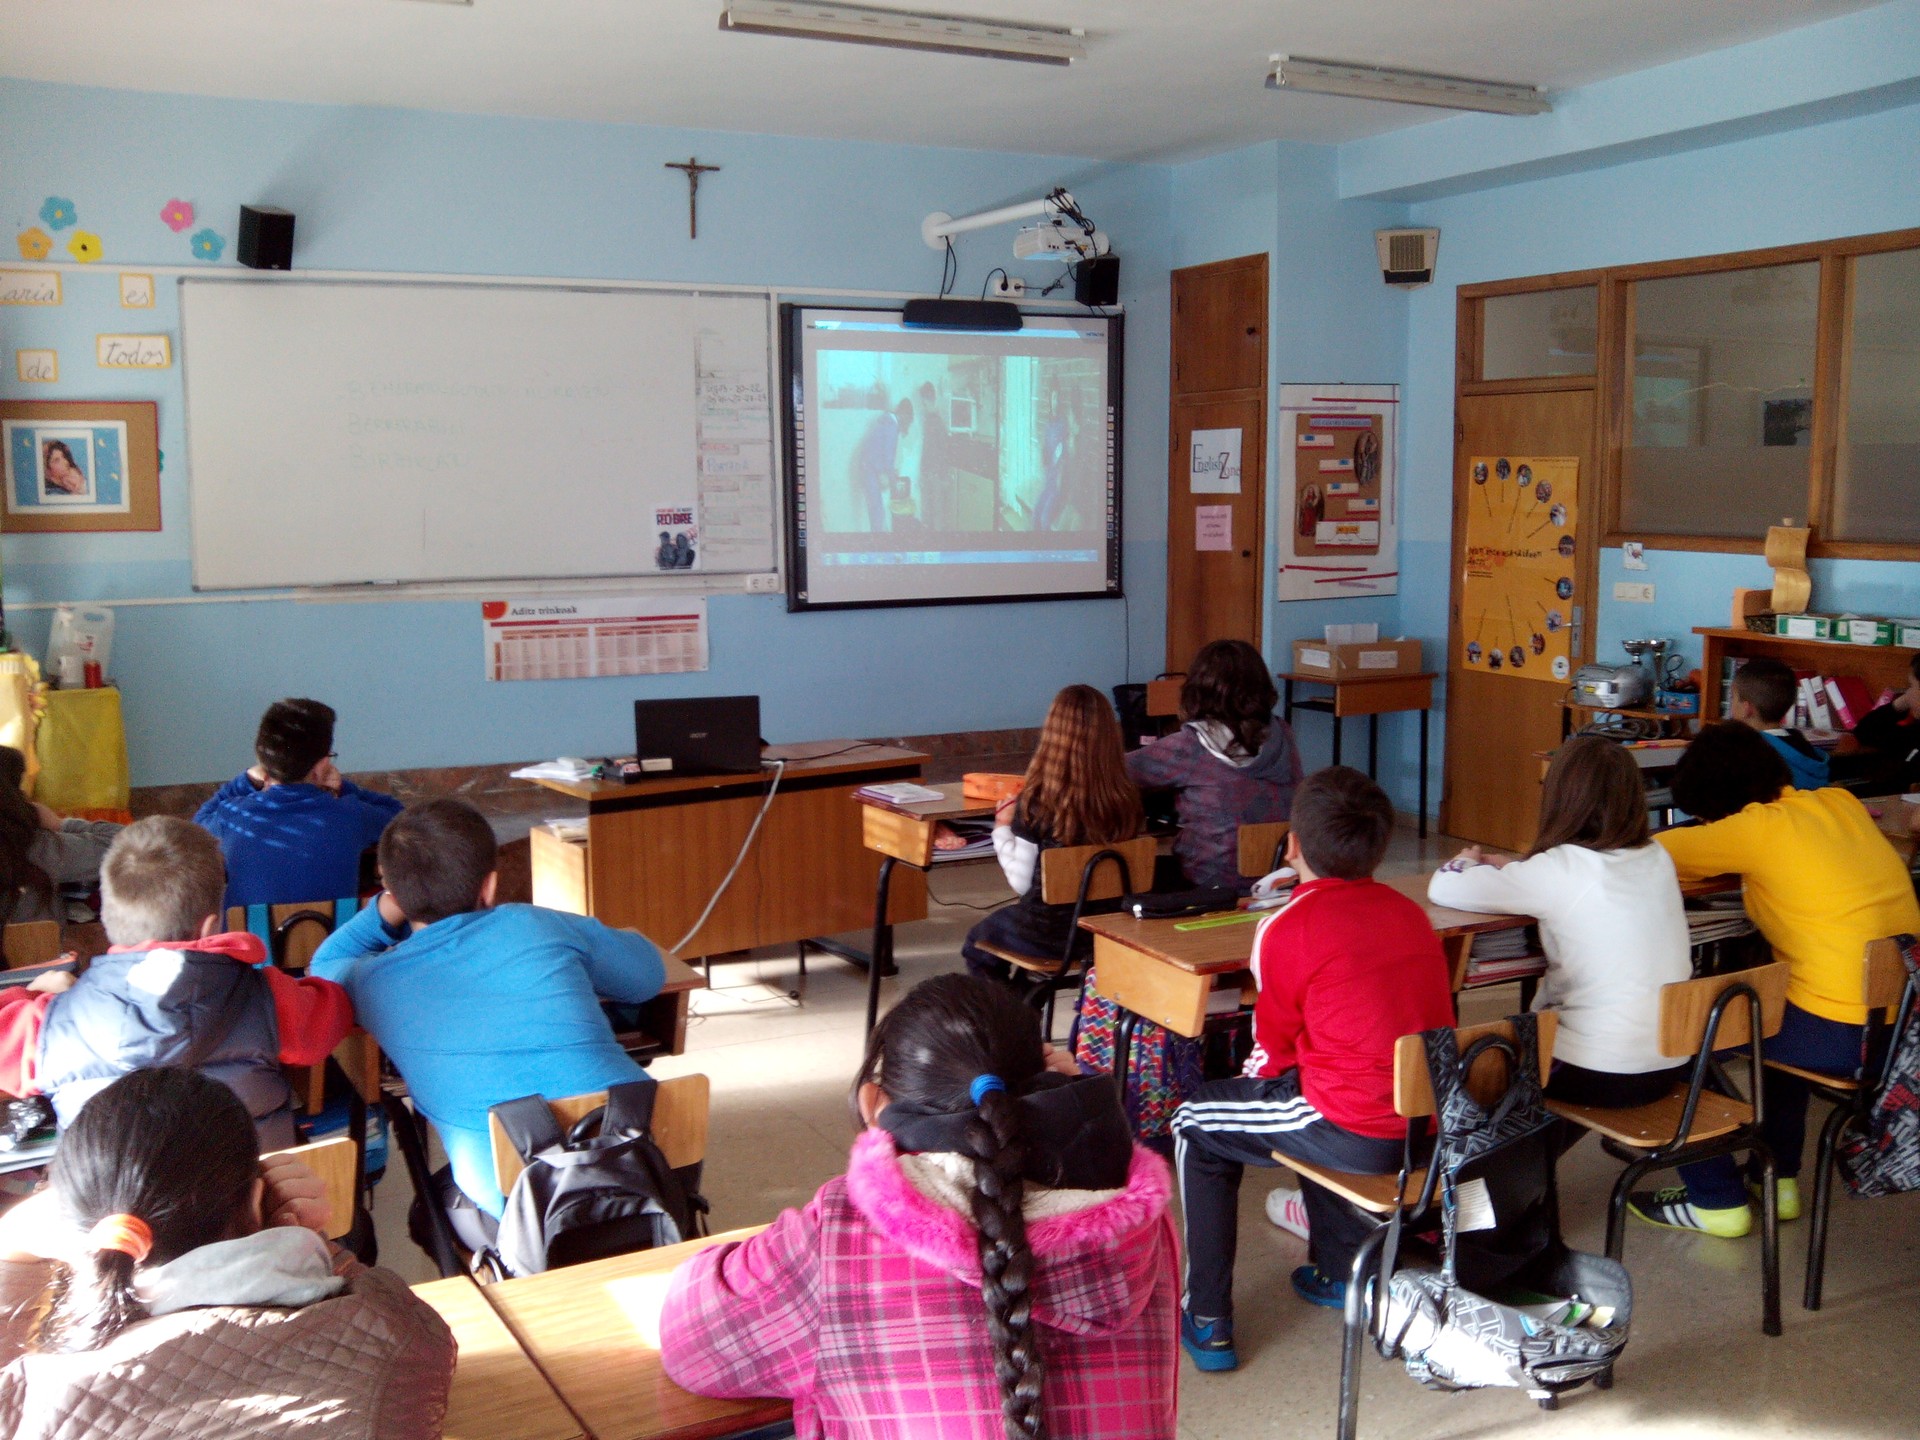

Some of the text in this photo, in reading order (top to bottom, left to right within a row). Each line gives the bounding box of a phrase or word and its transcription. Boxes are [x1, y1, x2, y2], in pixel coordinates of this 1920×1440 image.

[126, 289, 149, 304] es
[27, 340, 165, 380] de todos
[1193, 444, 1241, 479] English Zone
